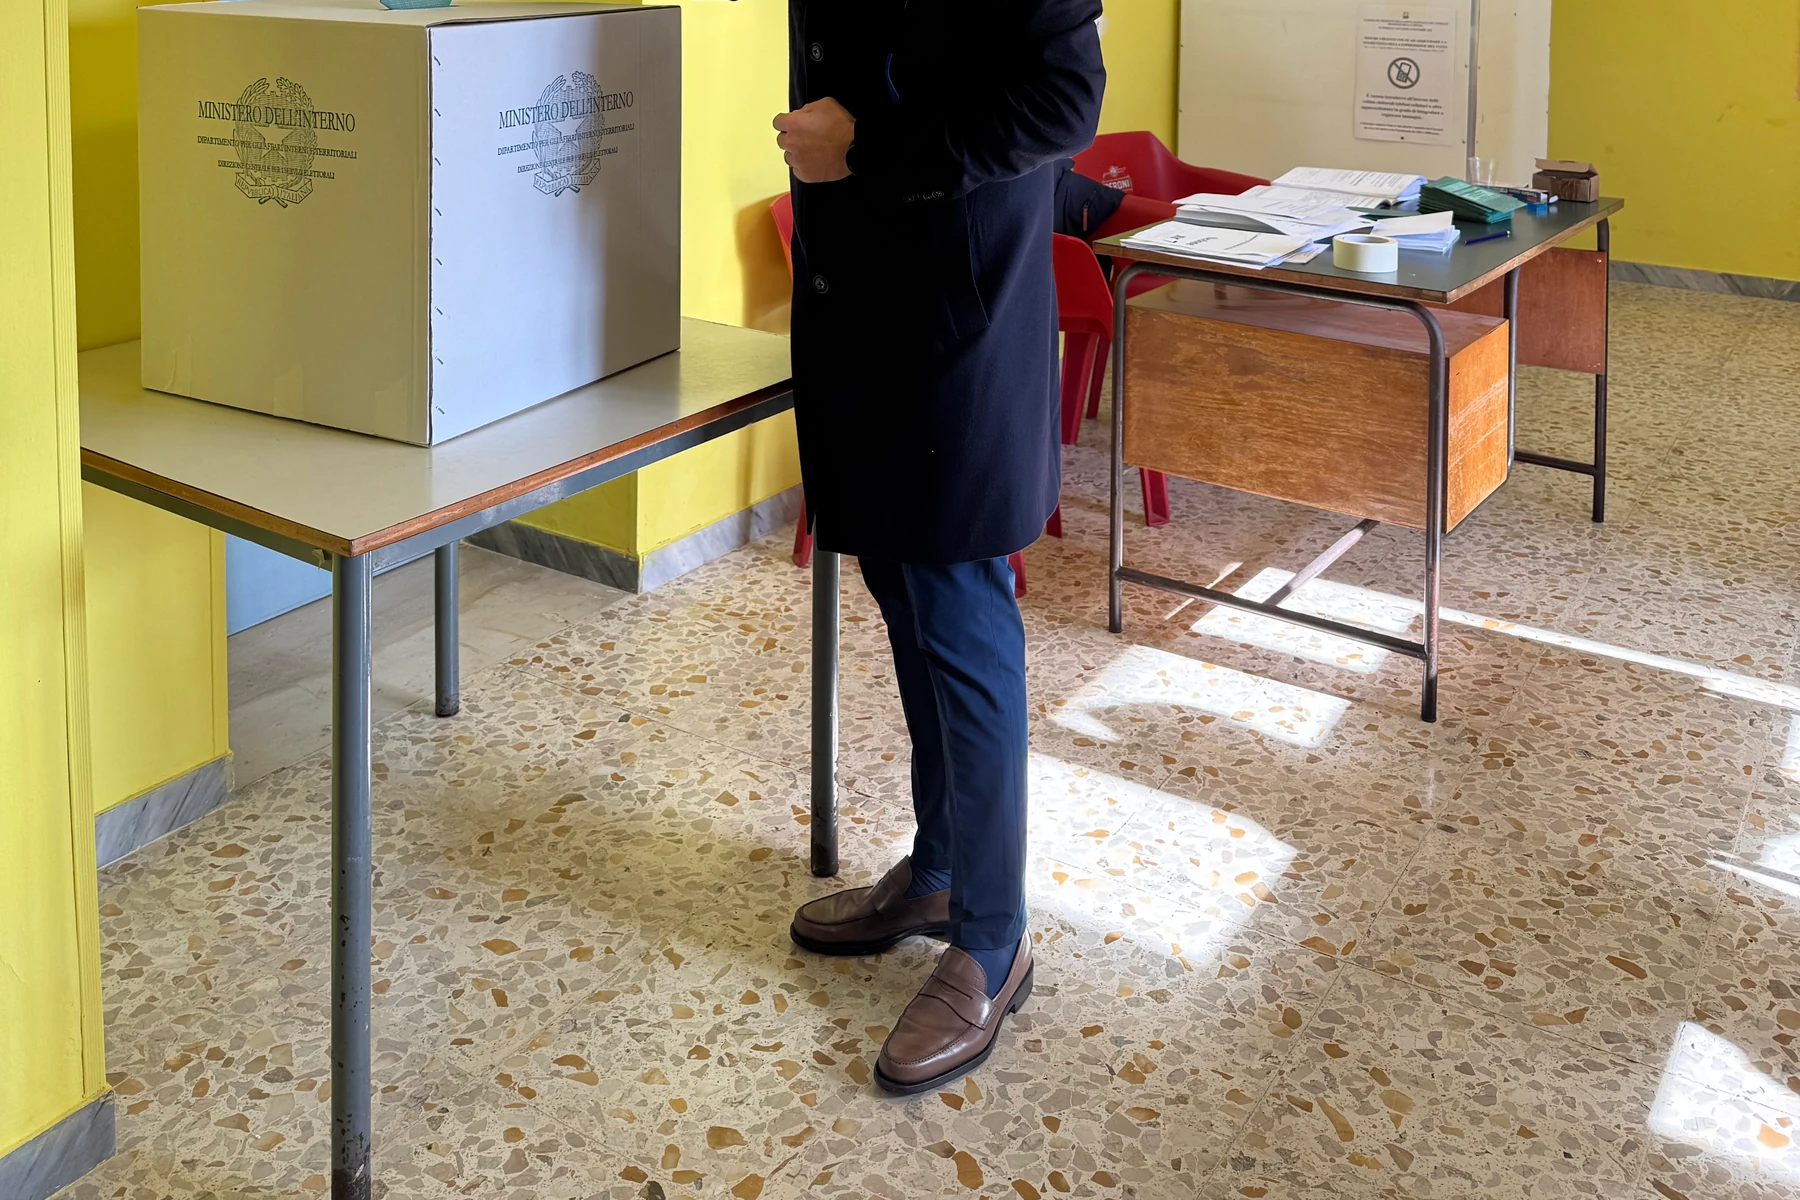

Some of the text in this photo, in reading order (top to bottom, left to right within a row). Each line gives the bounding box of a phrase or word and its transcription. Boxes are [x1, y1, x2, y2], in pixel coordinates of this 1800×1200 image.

[198, 100, 356, 132] MINISTERO DELL'INTERNO
[499, 91, 634, 129] MINISTERO DELL'INTERNO
[197, 136, 239, 148] DIPARTIMENTO
[240, 140, 252, 148] PER
[264, 143, 284, 152] AFFARI
[284, 145, 309, 154] INTERNI
[315, 148, 357, 159] TERRITORIALI
[498, 141, 539, 155] DIPARTIMENTO
[539, 138, 549, 147] PER
[550, 137, 559, 146] GLI
[560, 134, 577, 143] AFFARI
[577, 130, 598, 141] INTERNI
[601, 123, 635, 136] TERRITORIALI
[218, 160, 245, 169] DIREZIONE
[246, 162, 271, 172] CENTRALE
[284, 167, 303, 176] SERVIZI
[304, 170, 335, 180] ELETTORALI
[518, 162, 544, 173] DIREZIONE
[535, 165, 599, 192] REPVBBLICA ITALIANA
[236, 179, 311, 202] REPVBBLICA ITALIANA
